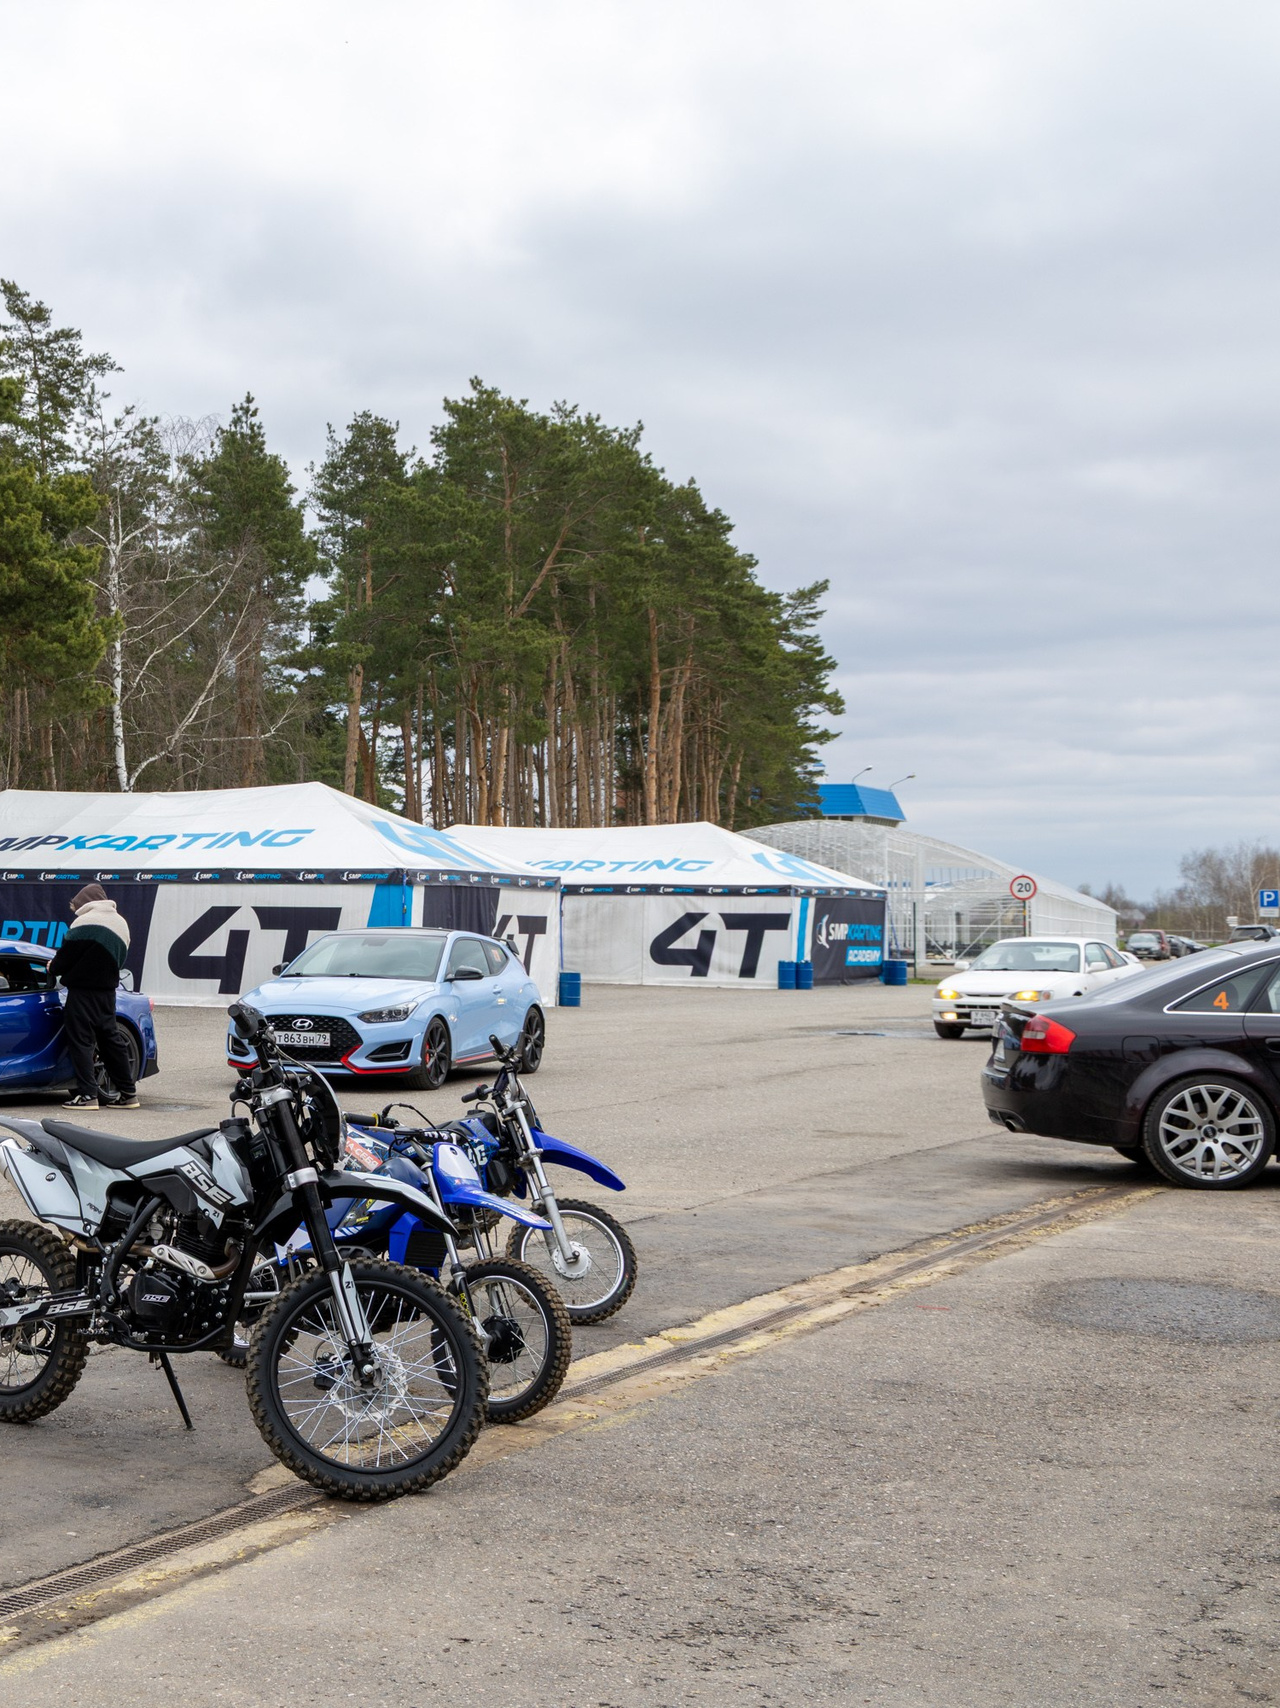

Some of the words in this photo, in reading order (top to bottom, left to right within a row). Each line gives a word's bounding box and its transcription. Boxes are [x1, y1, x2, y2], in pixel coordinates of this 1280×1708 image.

[1016, 882, 1032, 893] 20
[1263, 891, 1276, 906] P
[167, 906, 342, 995] 4T
[649, 911, 791, 978] 4T
[1213, 991, 1230, 1010] 4
[180, 1161, 233, 1206] BSE
[45, 1299, 95, 1316] BSE
